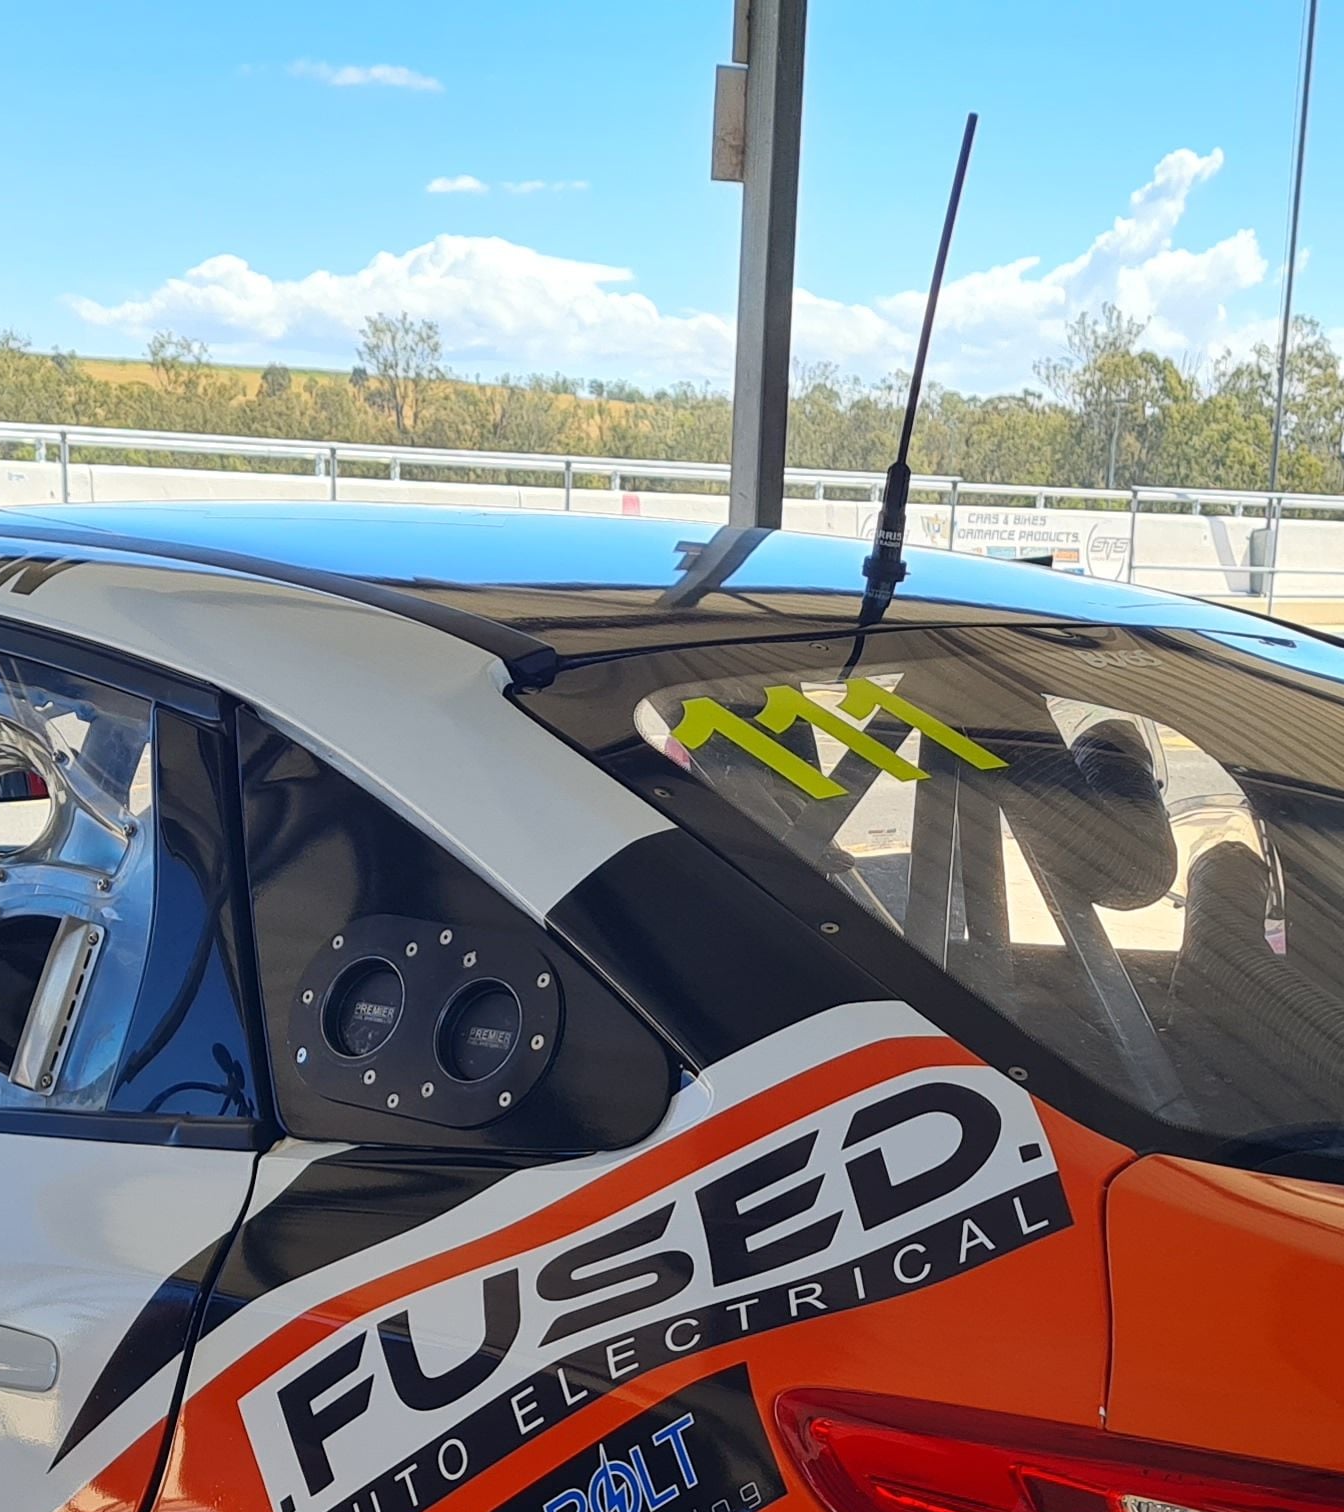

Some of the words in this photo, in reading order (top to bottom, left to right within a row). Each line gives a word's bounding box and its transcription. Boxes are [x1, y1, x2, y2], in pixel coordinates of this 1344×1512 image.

[958, 528, 1016, 541] ORMANCE
[355, 1001, 396, 1017] PREMIER
[470, 1027, 512, 1044] PREMIER
[512, 1194, 1052, 1434] ELECTRICAL
